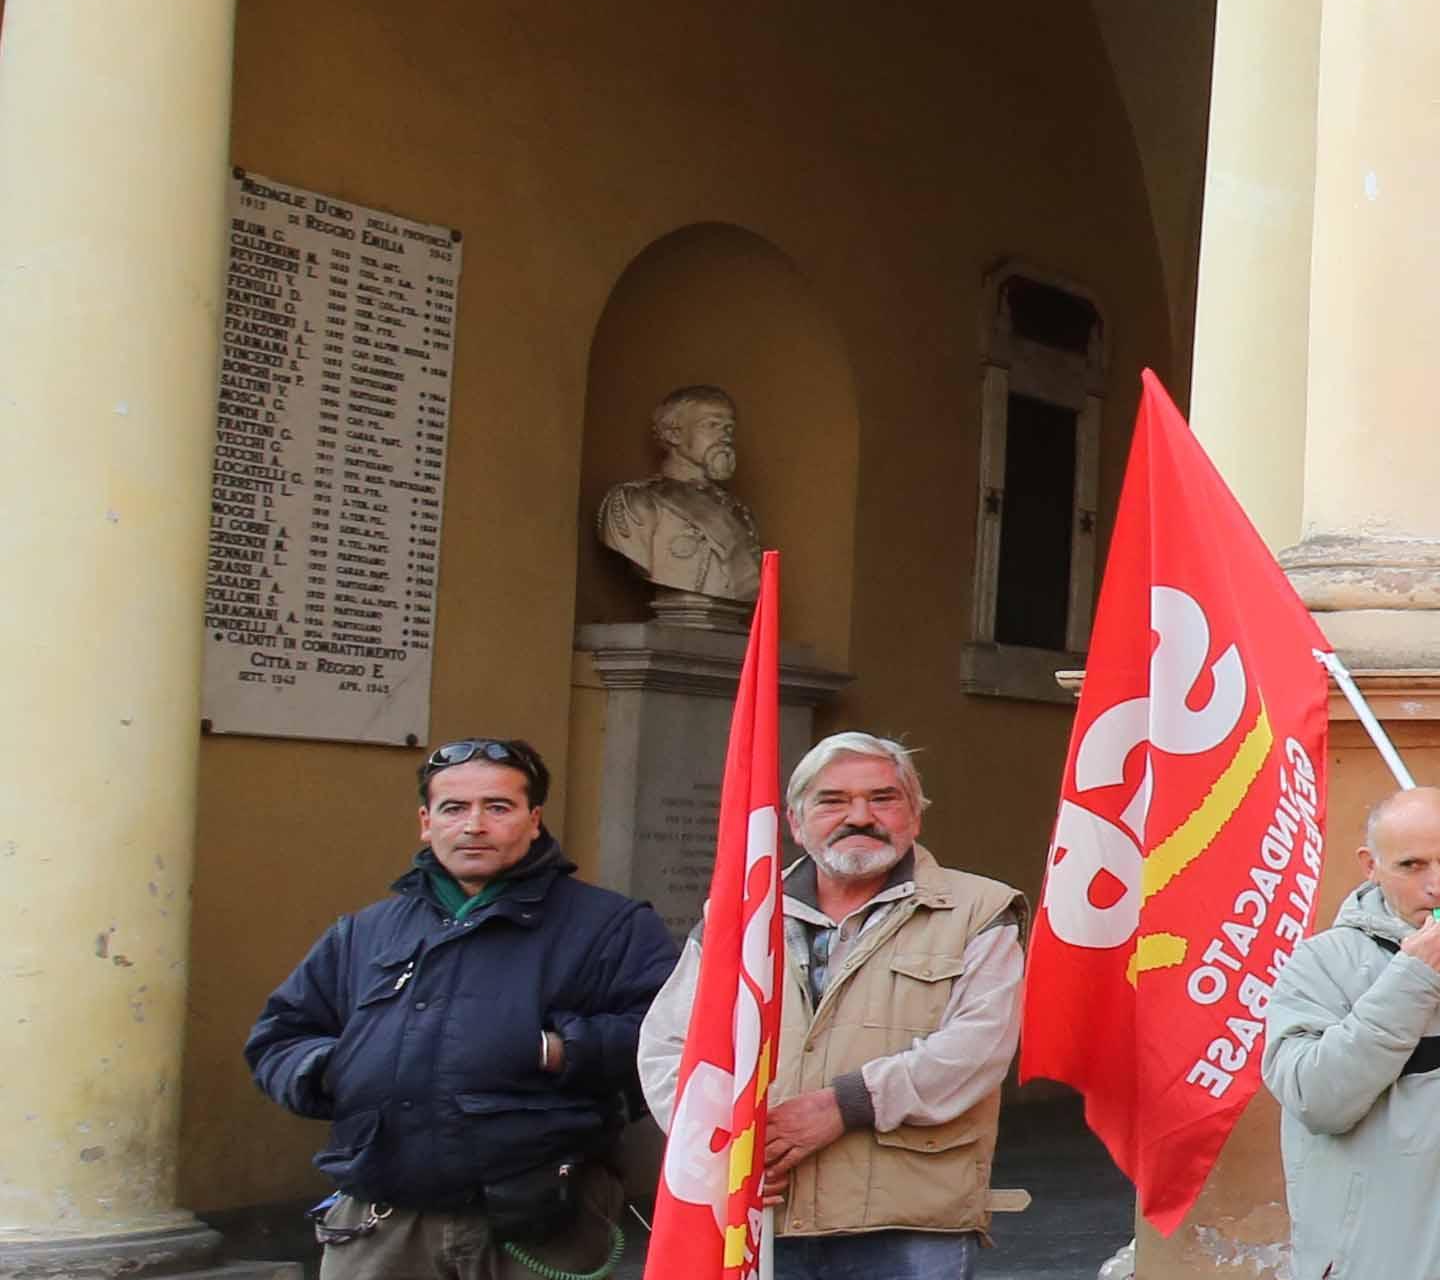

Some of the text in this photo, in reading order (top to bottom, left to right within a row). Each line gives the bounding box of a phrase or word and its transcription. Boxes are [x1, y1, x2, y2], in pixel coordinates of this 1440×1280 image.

[240, 179, 307, 208] MEDAGLIE
[305, 214, 405, 255] REGGIO EMILIA
[219, 387, 265, 408] MOSCA
[217, 431, 265, 451] VECCHI
[214, 459, 287, 482] LOCATELLI
[212, 473, 274, 495] FERRETTI
[227, 631, 407, 661] CADUTI IN COMBATTIMENTO
[317, 658, 366, 677] REGGIO
